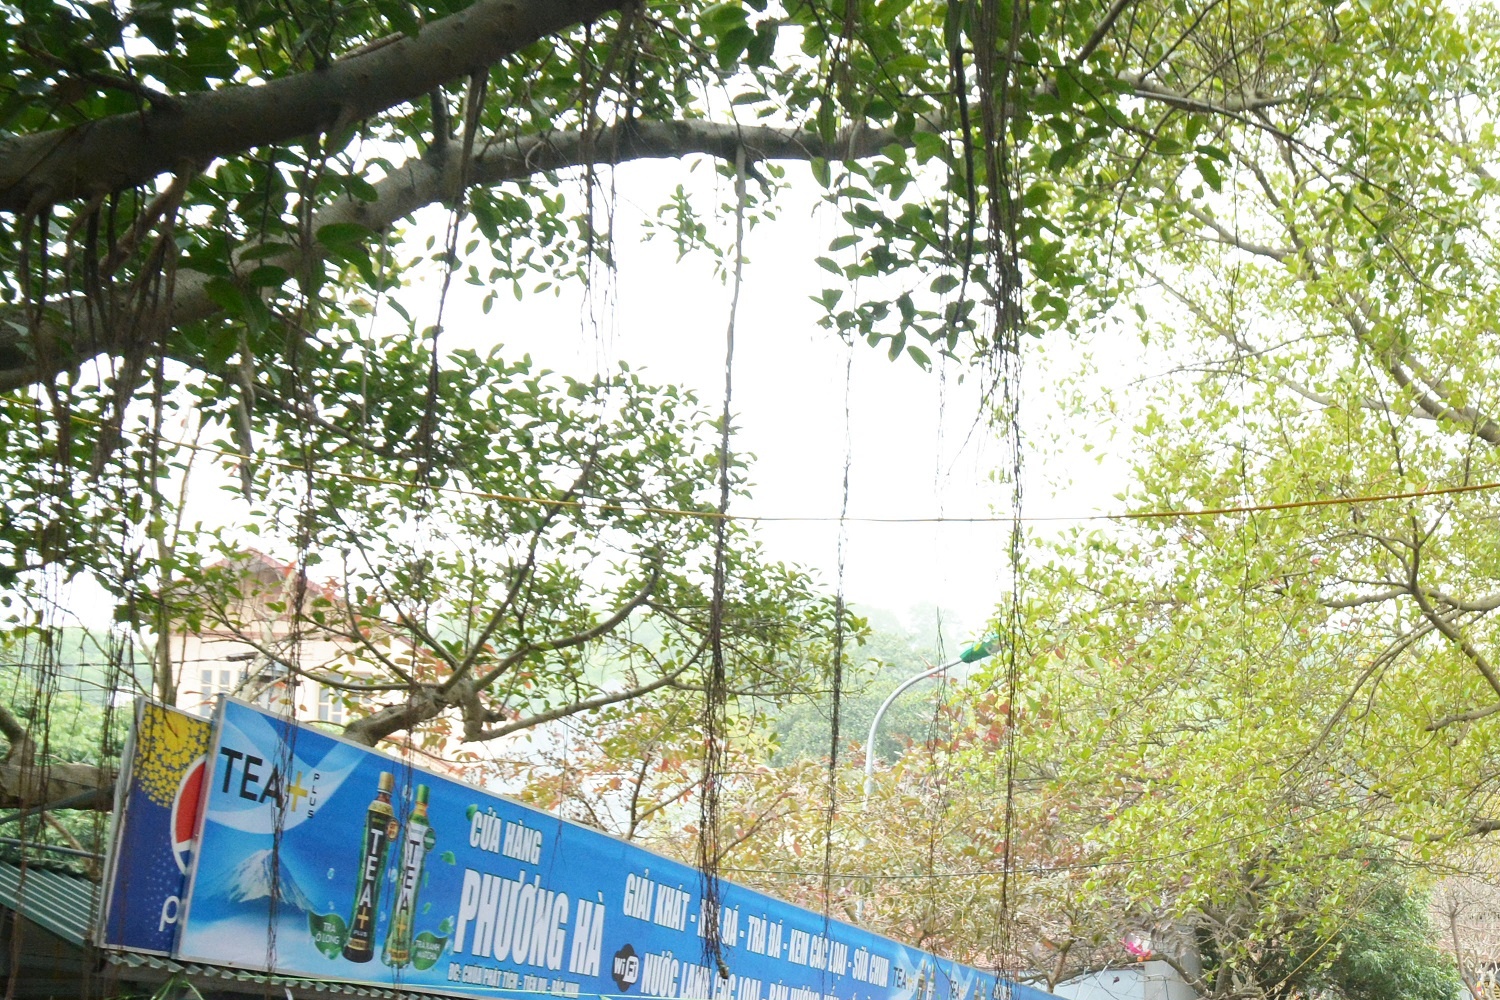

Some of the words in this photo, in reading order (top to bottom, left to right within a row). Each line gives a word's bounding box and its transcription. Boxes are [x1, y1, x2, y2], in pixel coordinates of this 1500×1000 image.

[307, 773, 320, 819] PLUS
[469, 806, 501, 854] CỬA
[502, 819, 543, 866] HÀNG
[453, 868, 569, 971] PHƯƠNG
[569, 890, 606, 977] HÀ
[623, 868, 654, 922] GIẢI
[654, 884, 691, 932] KHÁT
[721, 904, 740, 947] ĐÁ
[746, 913, 767, 955] TRÀ
[767, 919, 783, 959] ĐÁ
[788, 928, 810, 966] KEM
[640, 950, 679, 998] NƯỚC
